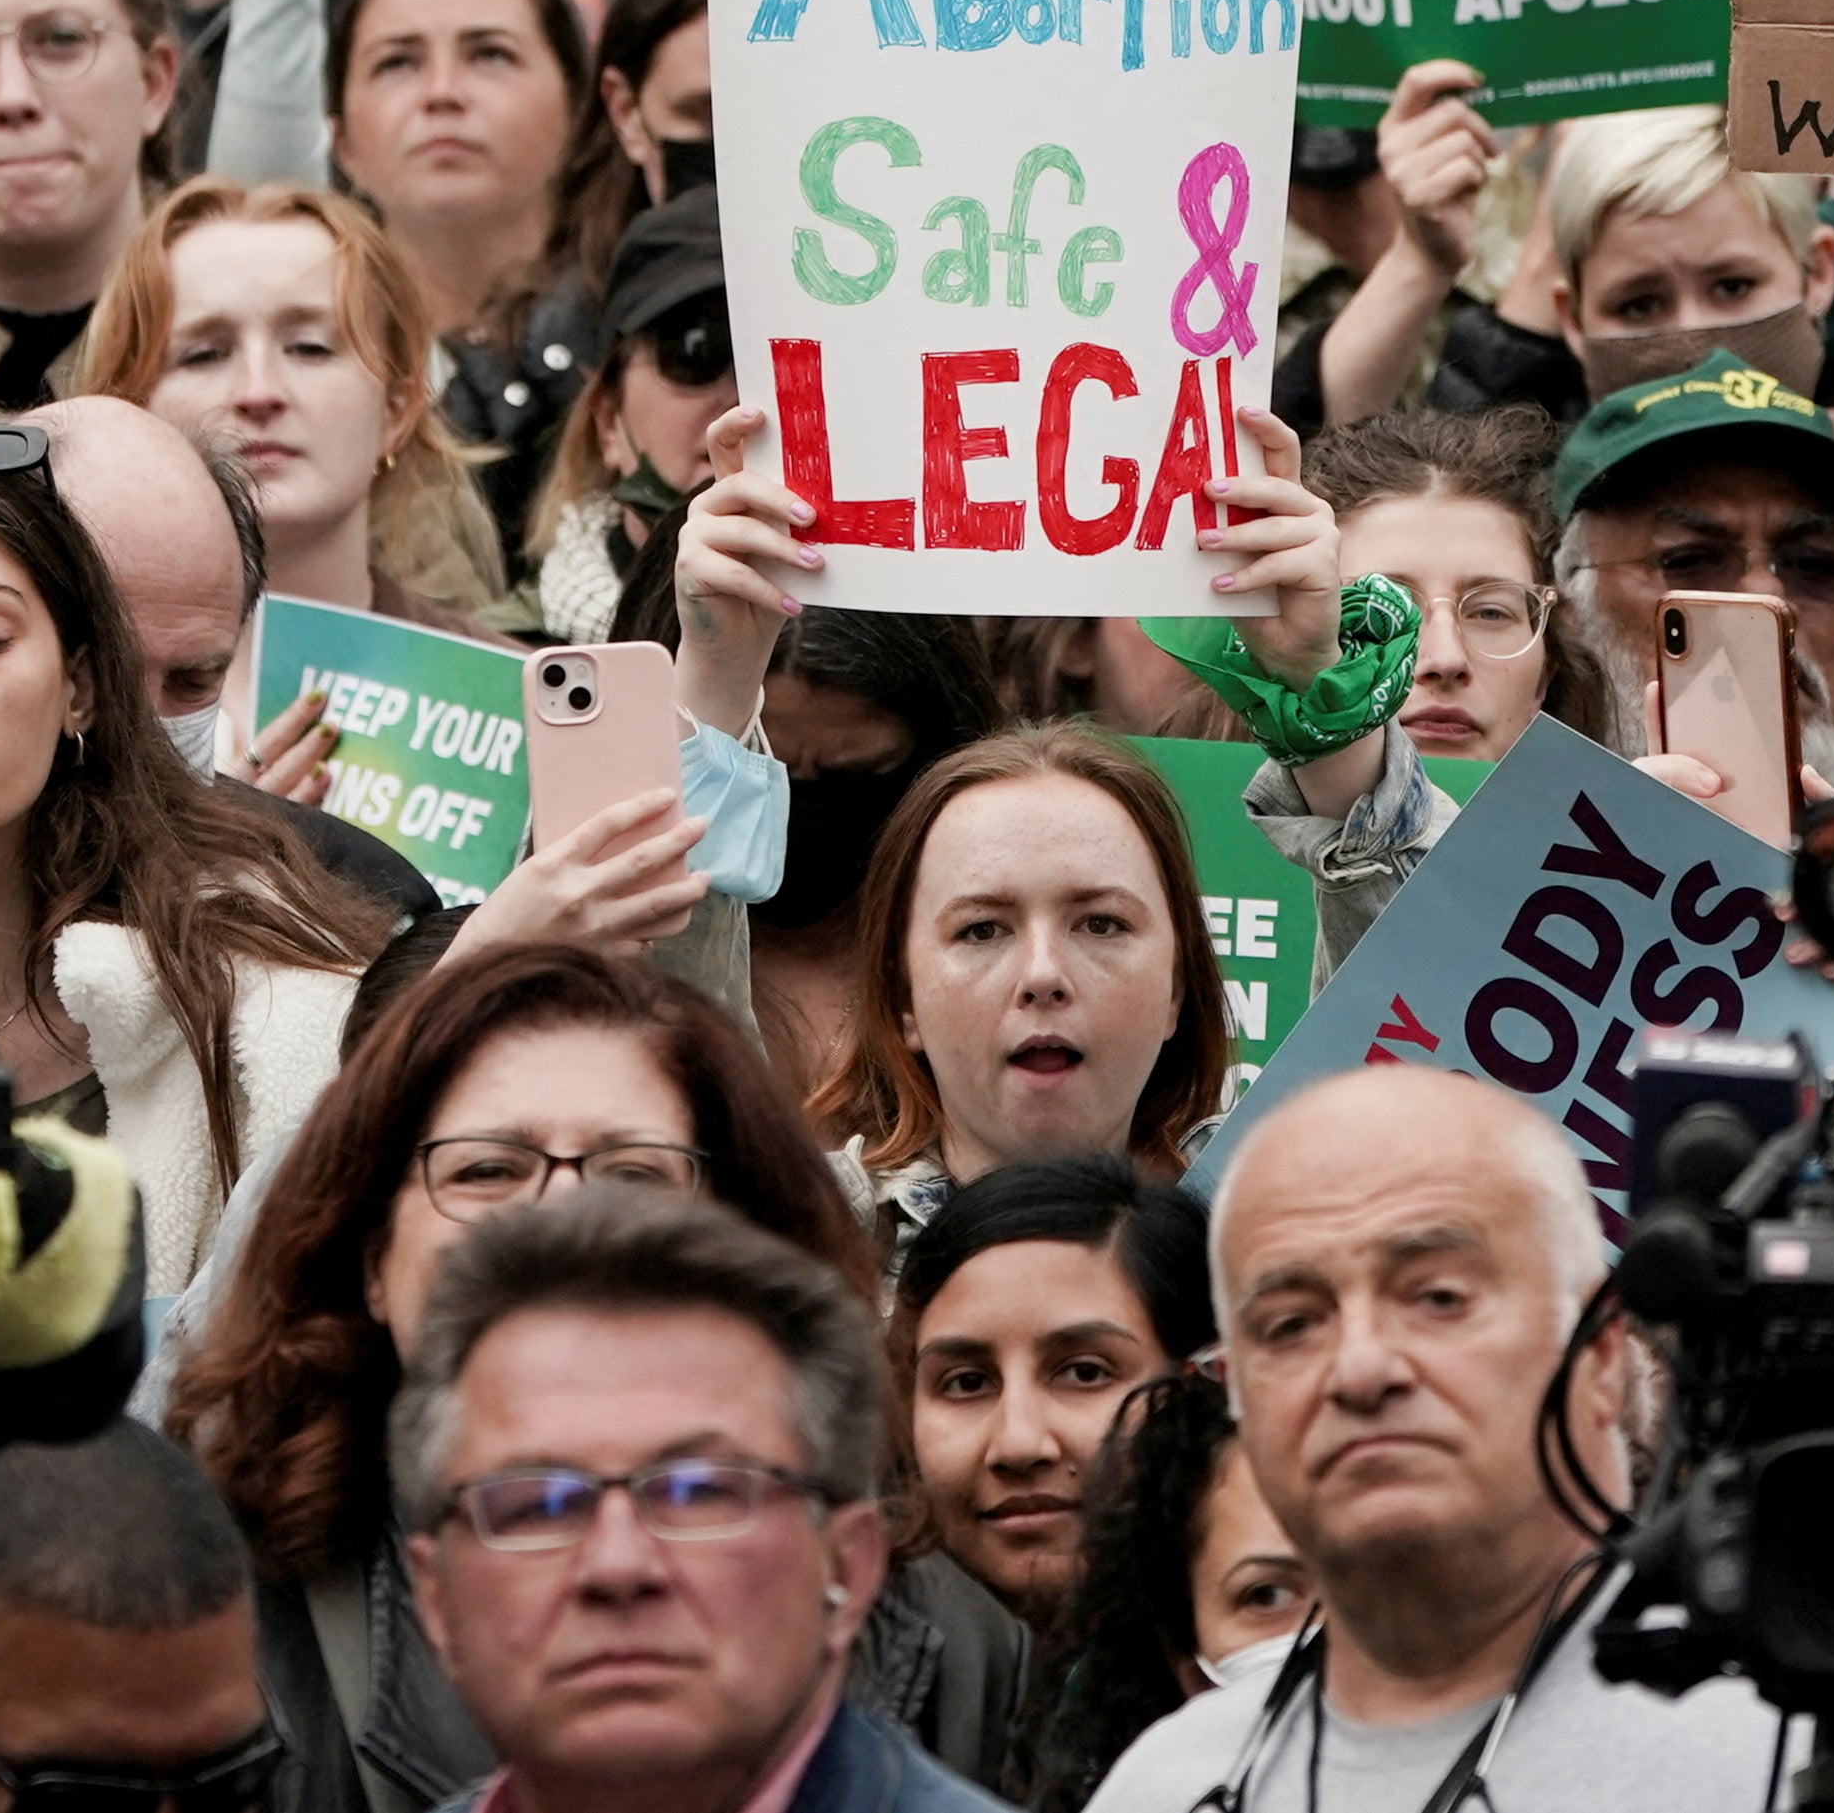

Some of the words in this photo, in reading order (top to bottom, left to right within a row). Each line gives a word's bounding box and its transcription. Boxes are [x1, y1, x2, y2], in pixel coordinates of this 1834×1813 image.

[792, 115, 1125, 317] Safe
[1170, 141, 1258, 359] &
[1722, 369, 1779, 409] 37
[409, 694, 525, 776] YOUR
[397, 783, 494, 850] OFF
[1451, 789, 1666, 1094] ODY
